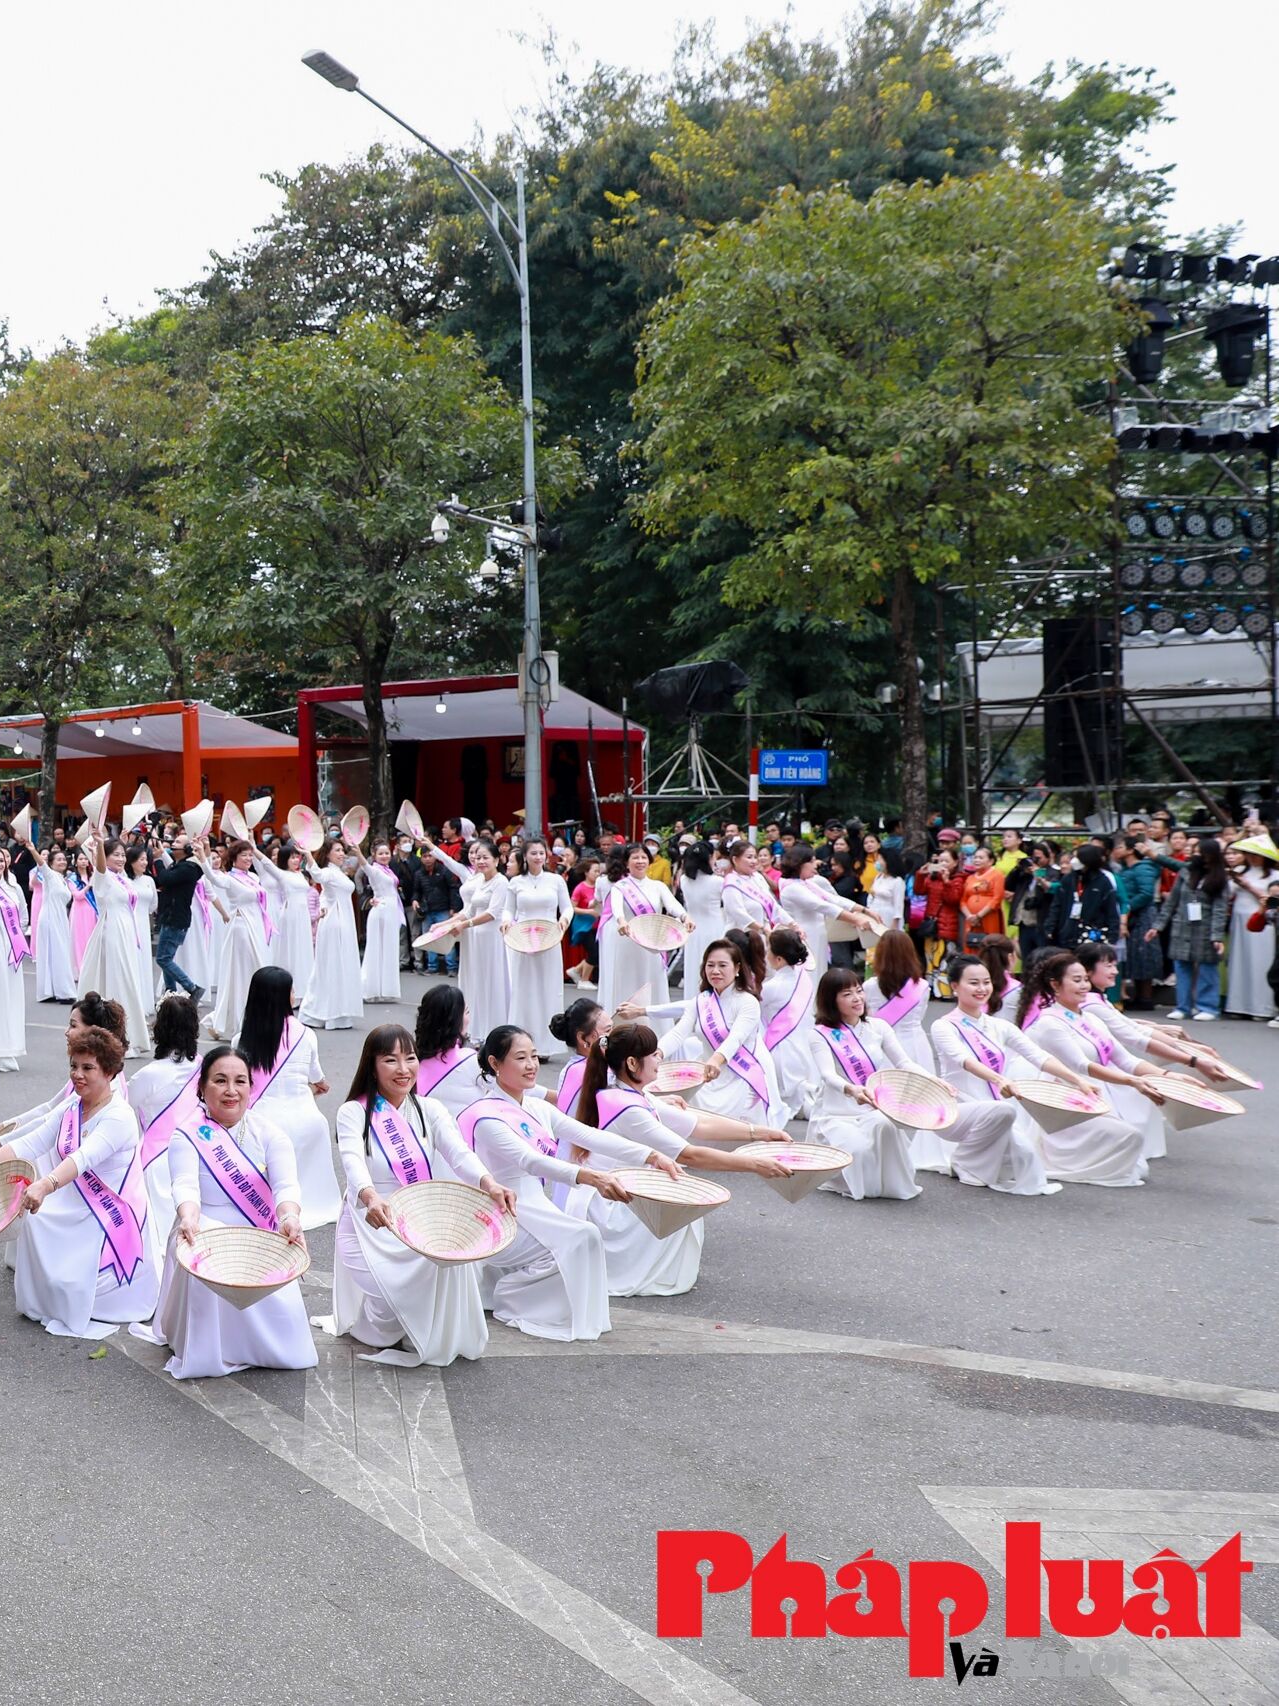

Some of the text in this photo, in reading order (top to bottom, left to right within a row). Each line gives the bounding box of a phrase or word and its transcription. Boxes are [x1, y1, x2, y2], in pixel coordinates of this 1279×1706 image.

[382, 1118, 398, 1135] PHỤ
[389, 1132, 405, 1146] NỮ
[212, 1144, 229, 1163] PHỤ
[395, 1143, 413, 1160] THỦ
[221, 1158, 238, 1172] NỮ
[401, 1157, 417, 1170] ĐÔ
[228, 1168, 249, 1185] THỦ
[237, 1181, 254, 1193] ĐÔ
[87, 1177, 104, 1195] LỊCH
[99, 1194, 115, 1211] VĂN
[108, 1207, 125, 1228] MINH
[244, 1188, 265, 1210] THANH
